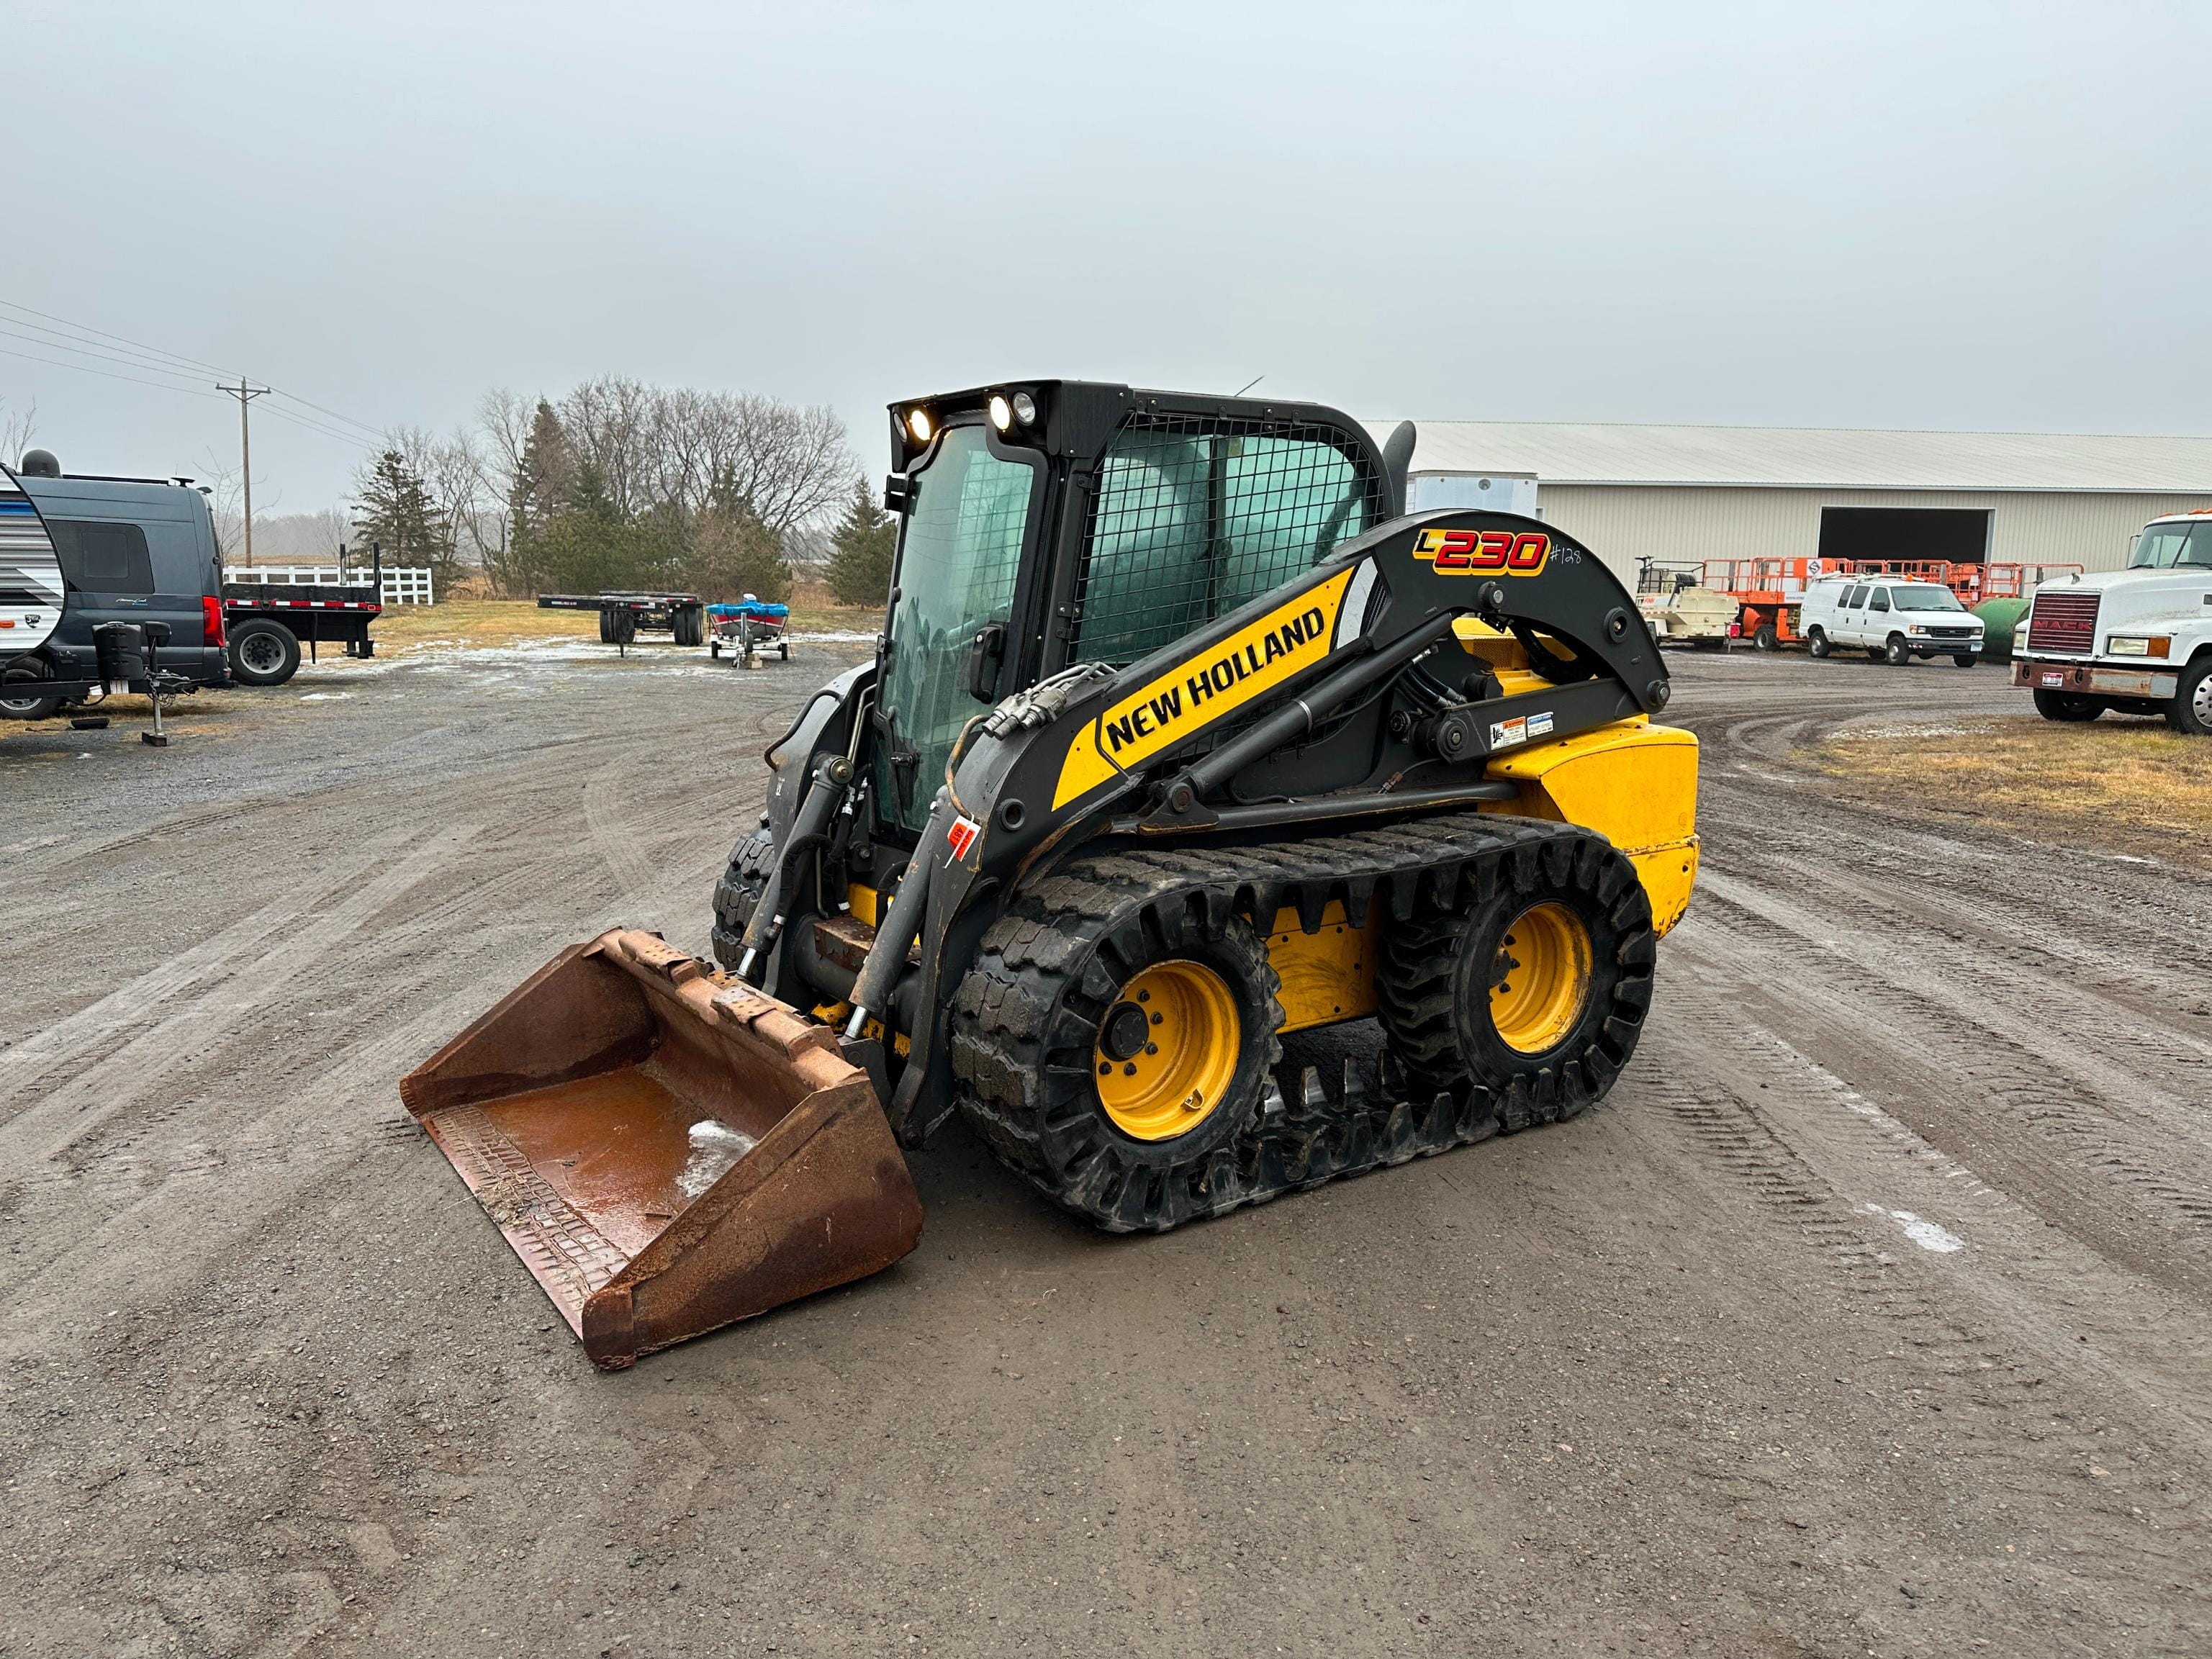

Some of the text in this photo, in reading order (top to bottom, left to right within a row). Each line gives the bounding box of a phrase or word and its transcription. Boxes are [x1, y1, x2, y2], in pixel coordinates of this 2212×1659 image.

[1416, 532, 1548, 569] L230
[1550, 544, 1581, 565] #128
[2033, 620, 2093, 630] MACK
[1106, 607, 1324, 754] NEW HOLLAND
